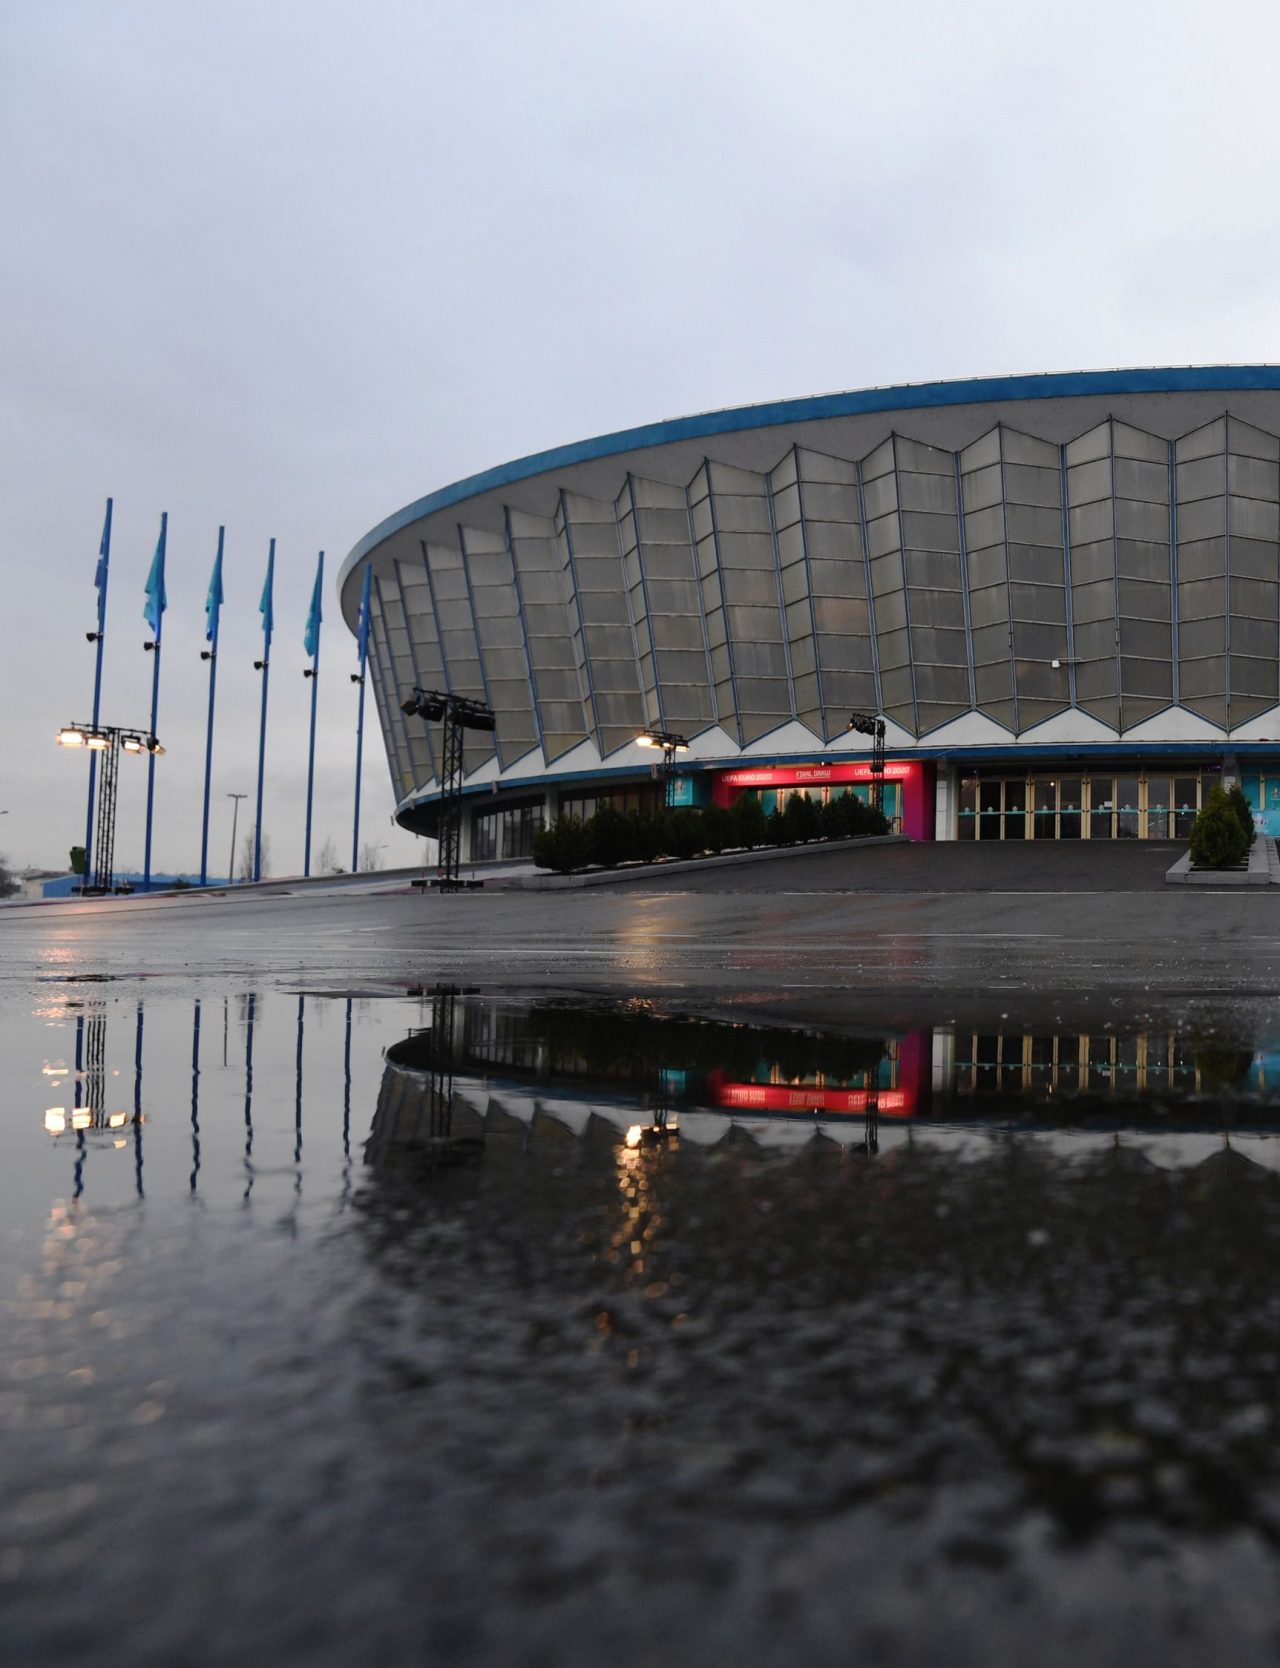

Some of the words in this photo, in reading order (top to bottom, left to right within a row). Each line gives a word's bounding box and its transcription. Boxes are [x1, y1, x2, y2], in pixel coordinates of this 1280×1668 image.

[813, 769, 831, 778] DRAW
[892, 766, 910, 775] 2020
[721, 774, 738, 783] UEFA
[738, 773, 756, 782] EURO
[756, 772, 773, 781] 2020
